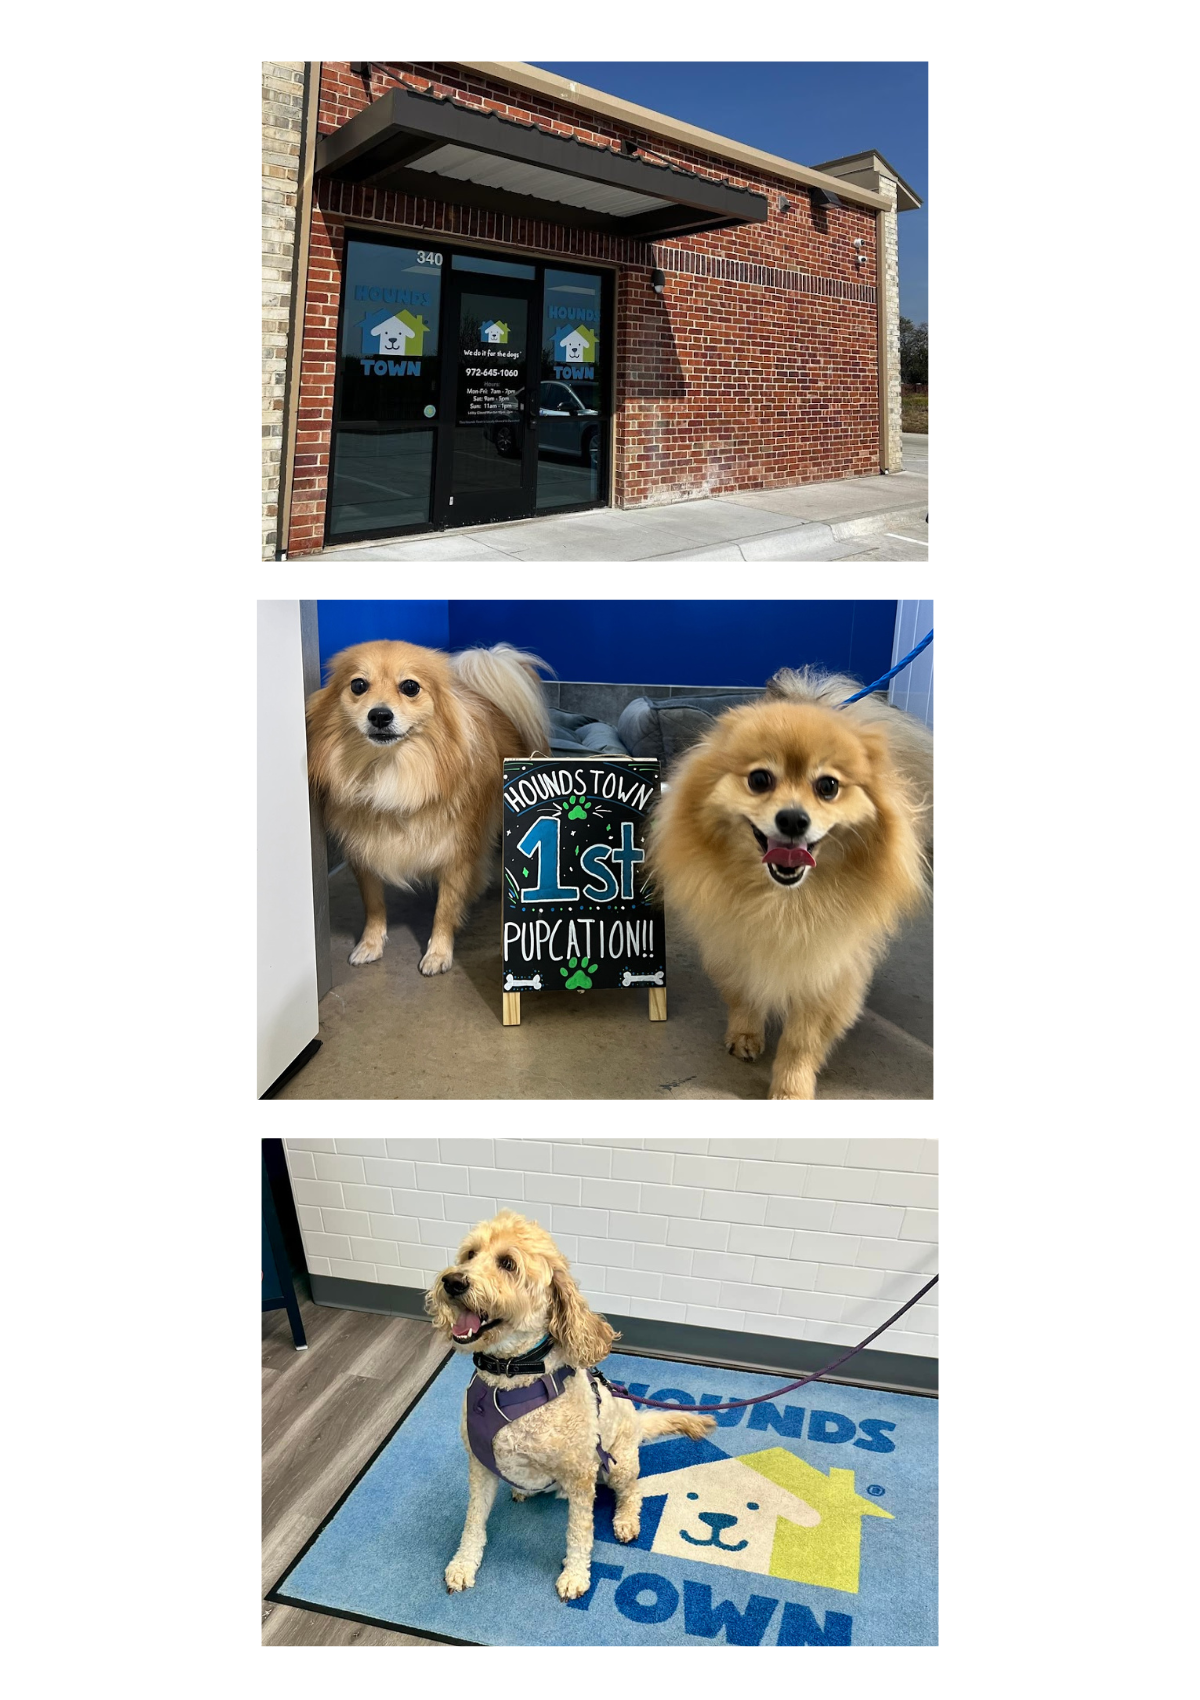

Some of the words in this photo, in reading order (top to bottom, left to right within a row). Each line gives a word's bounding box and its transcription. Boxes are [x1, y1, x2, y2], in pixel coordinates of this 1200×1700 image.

[416, 250, 443, 266] 340
[354, 285, 431, 306] HOUNDS
[549, 305, 601, 323] HOUNDS
[473, 349, 481, 357] do
[487, 349, 496, 358] for
[496, 350, 505, 358] the
[506, 351, 519, 359] dogs
[360, 359, 422, 377] TOWN
[465, 368, 519, 377] 972-645-1060
[553, 365, 595, 380] TOWN
[517, 816, 645, 903] 1st
[503, 919, 654, 962] PUPCATION!!
[566, 1561, 853, 1646] TOWN
